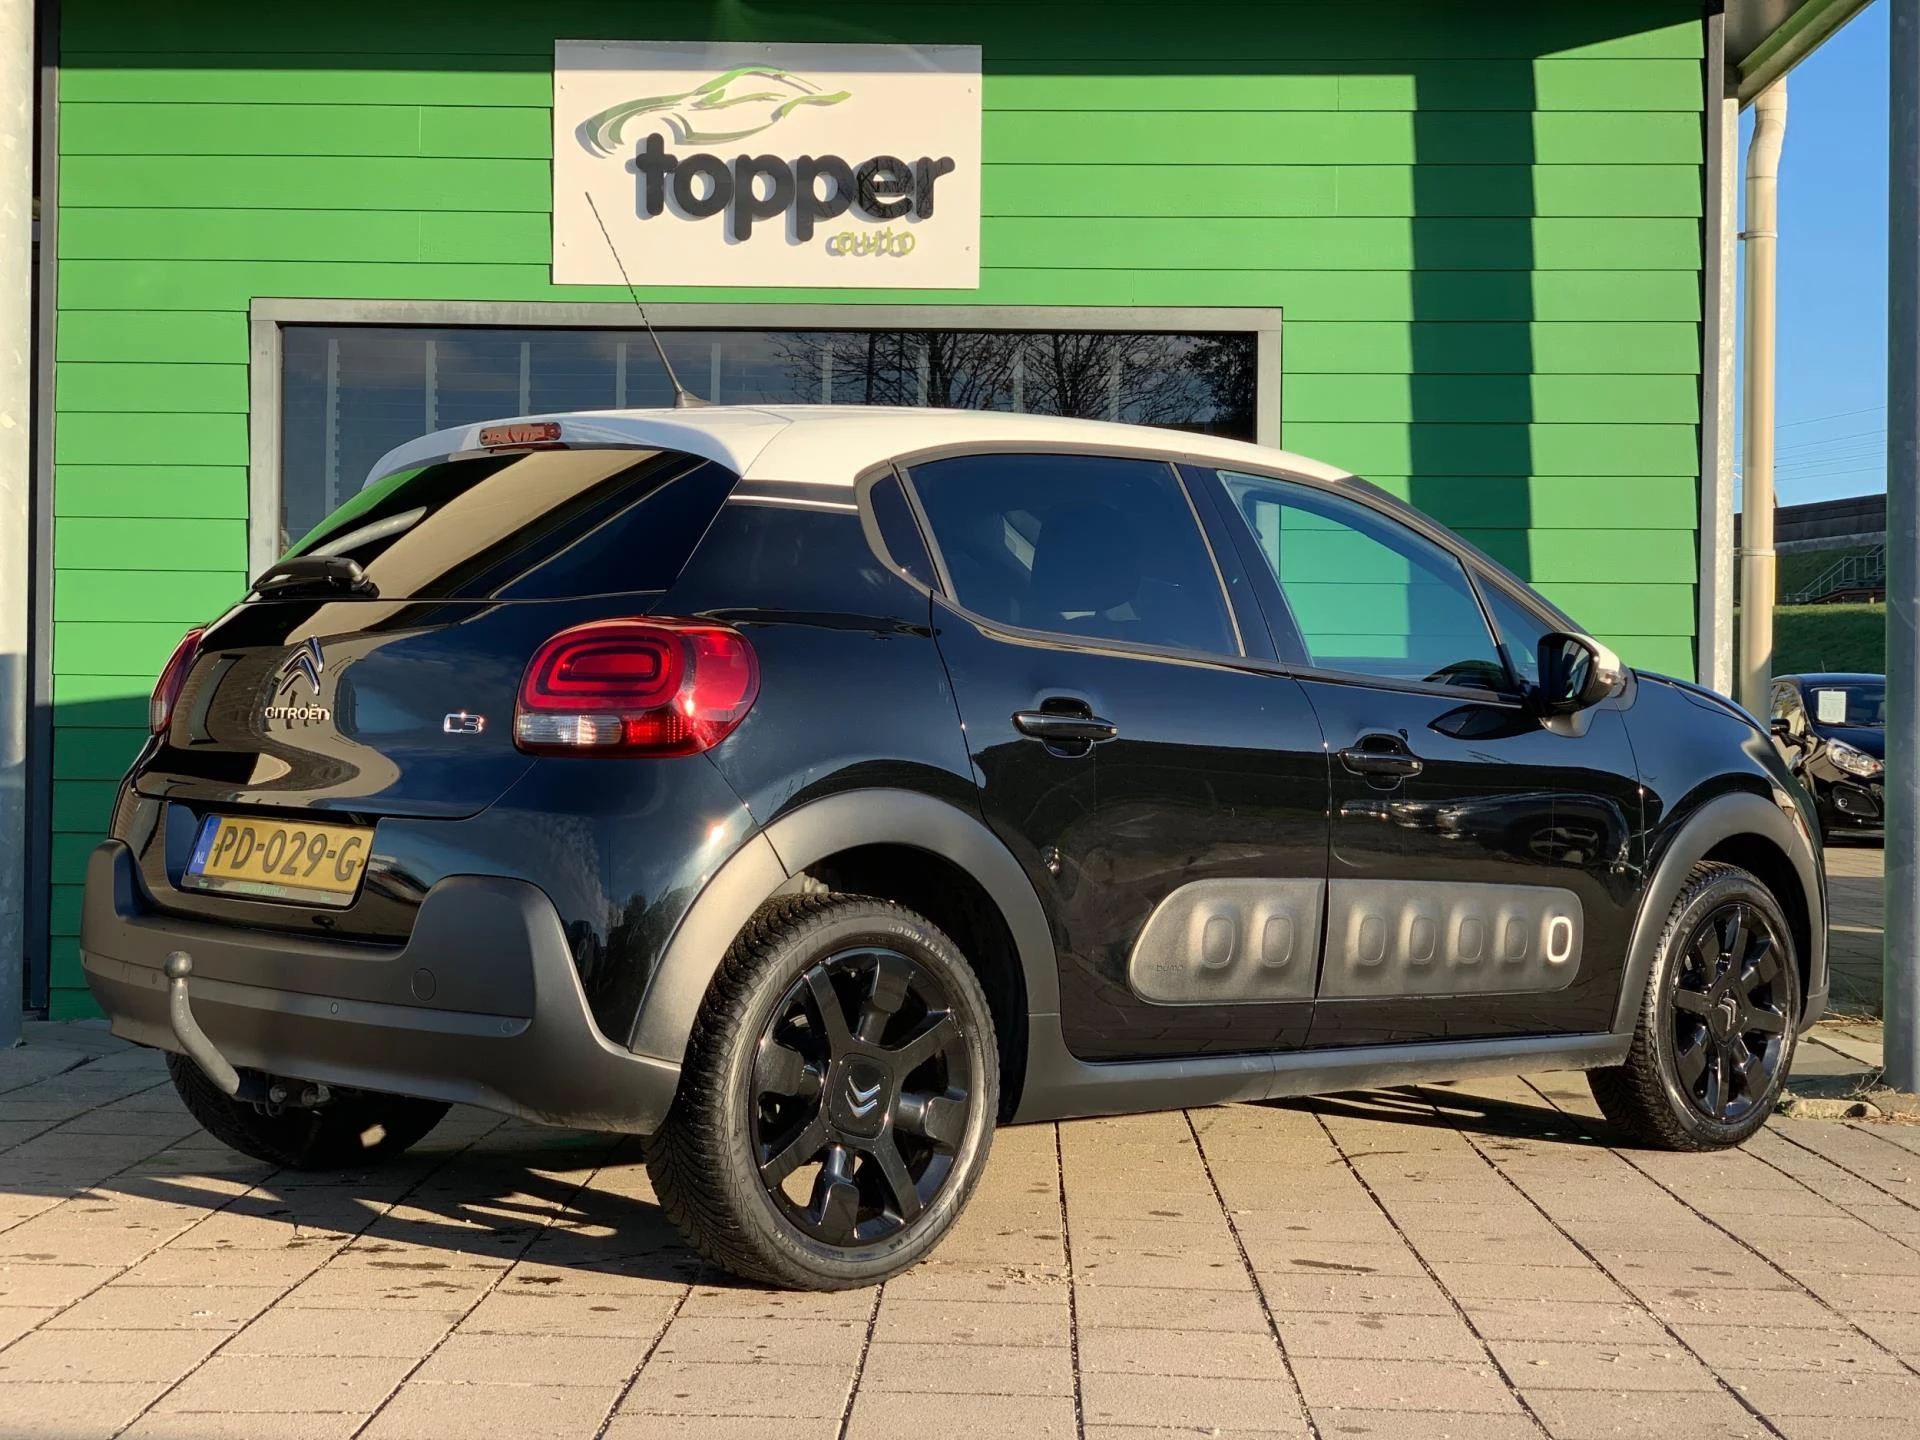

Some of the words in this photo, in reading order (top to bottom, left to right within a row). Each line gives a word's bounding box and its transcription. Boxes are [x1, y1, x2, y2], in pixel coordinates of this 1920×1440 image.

[635, 132, 956, 242] topper
[836, 226, 916, 255] auto
[193, 852, 205, 864] NL
[212, 825, 363, 882] PD-029-G
